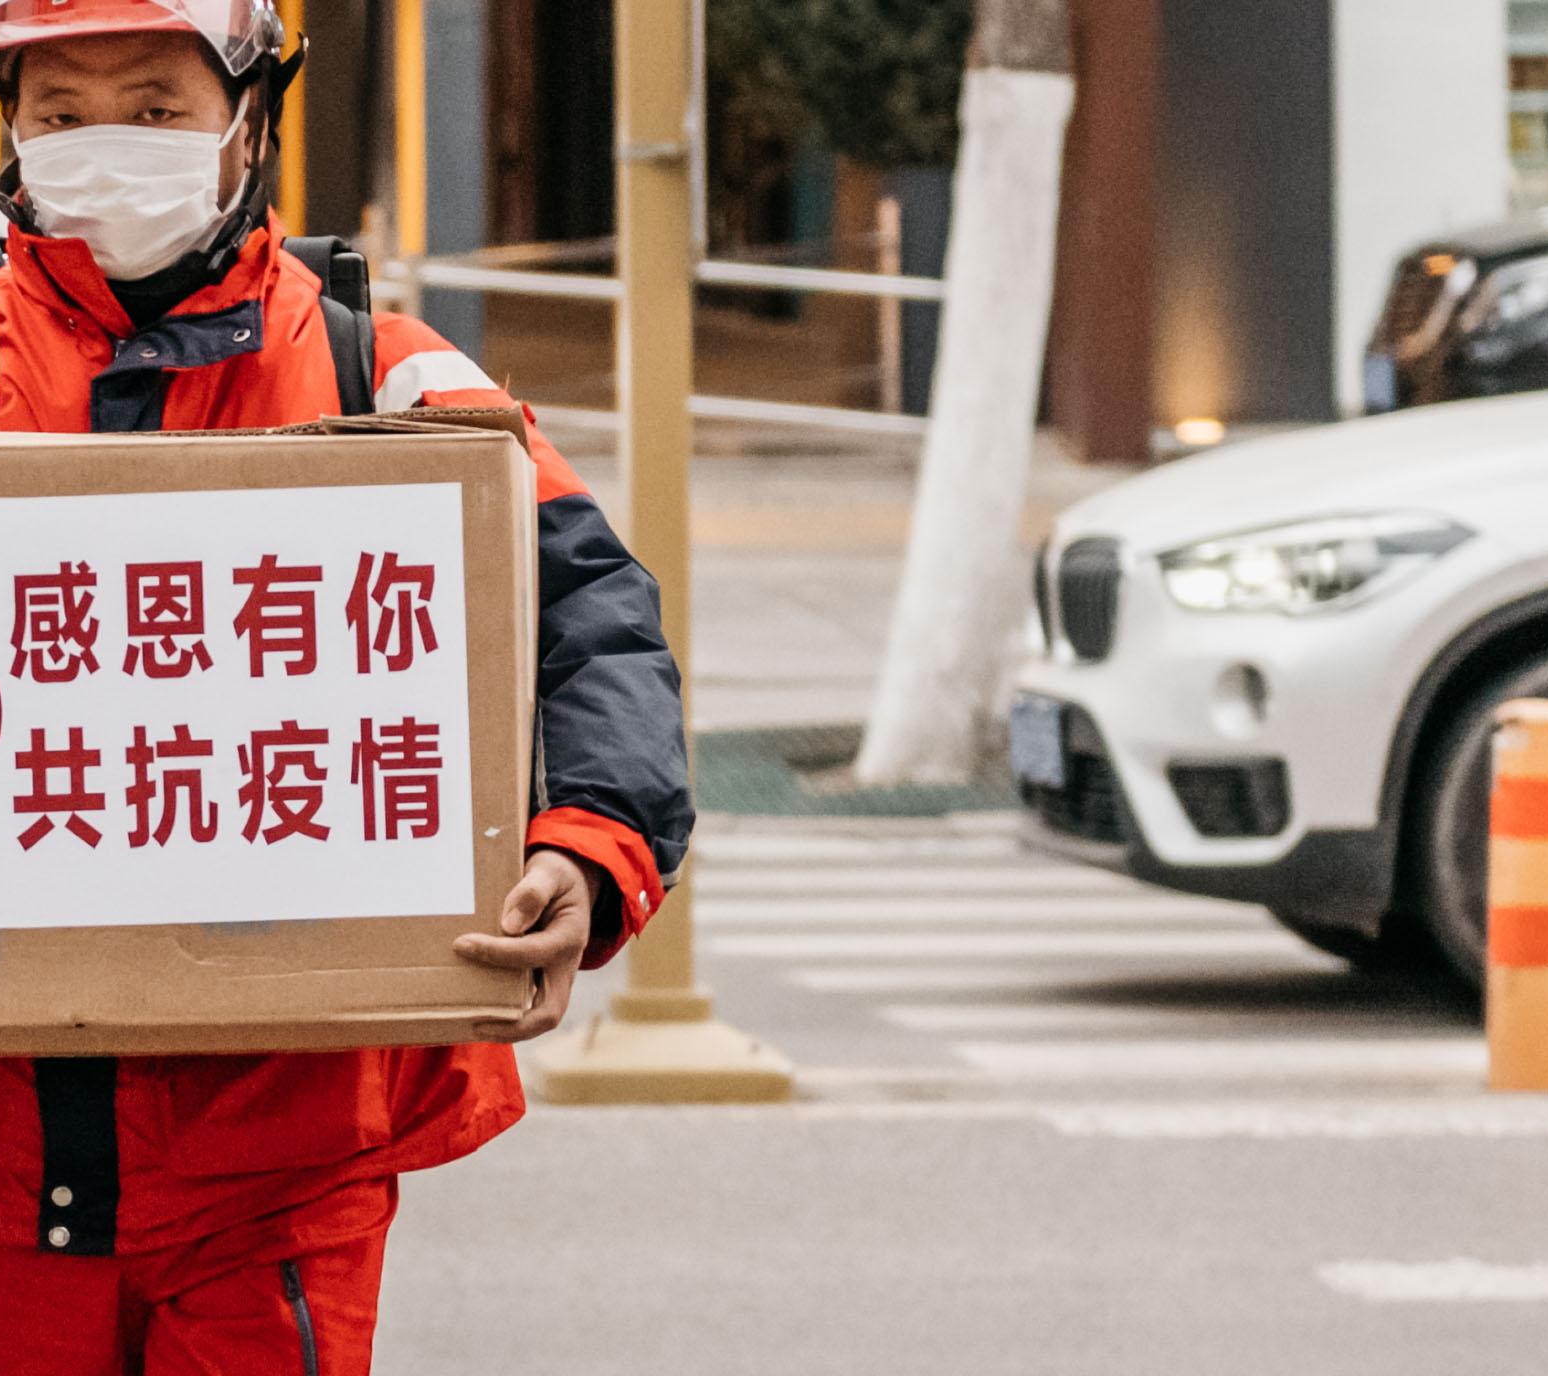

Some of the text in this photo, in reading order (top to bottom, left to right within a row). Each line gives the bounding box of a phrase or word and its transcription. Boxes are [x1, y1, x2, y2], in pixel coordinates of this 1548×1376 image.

[9, 551, 439, 684] 感恩有你
[13, 716, 443, 851] 共抗疫情
